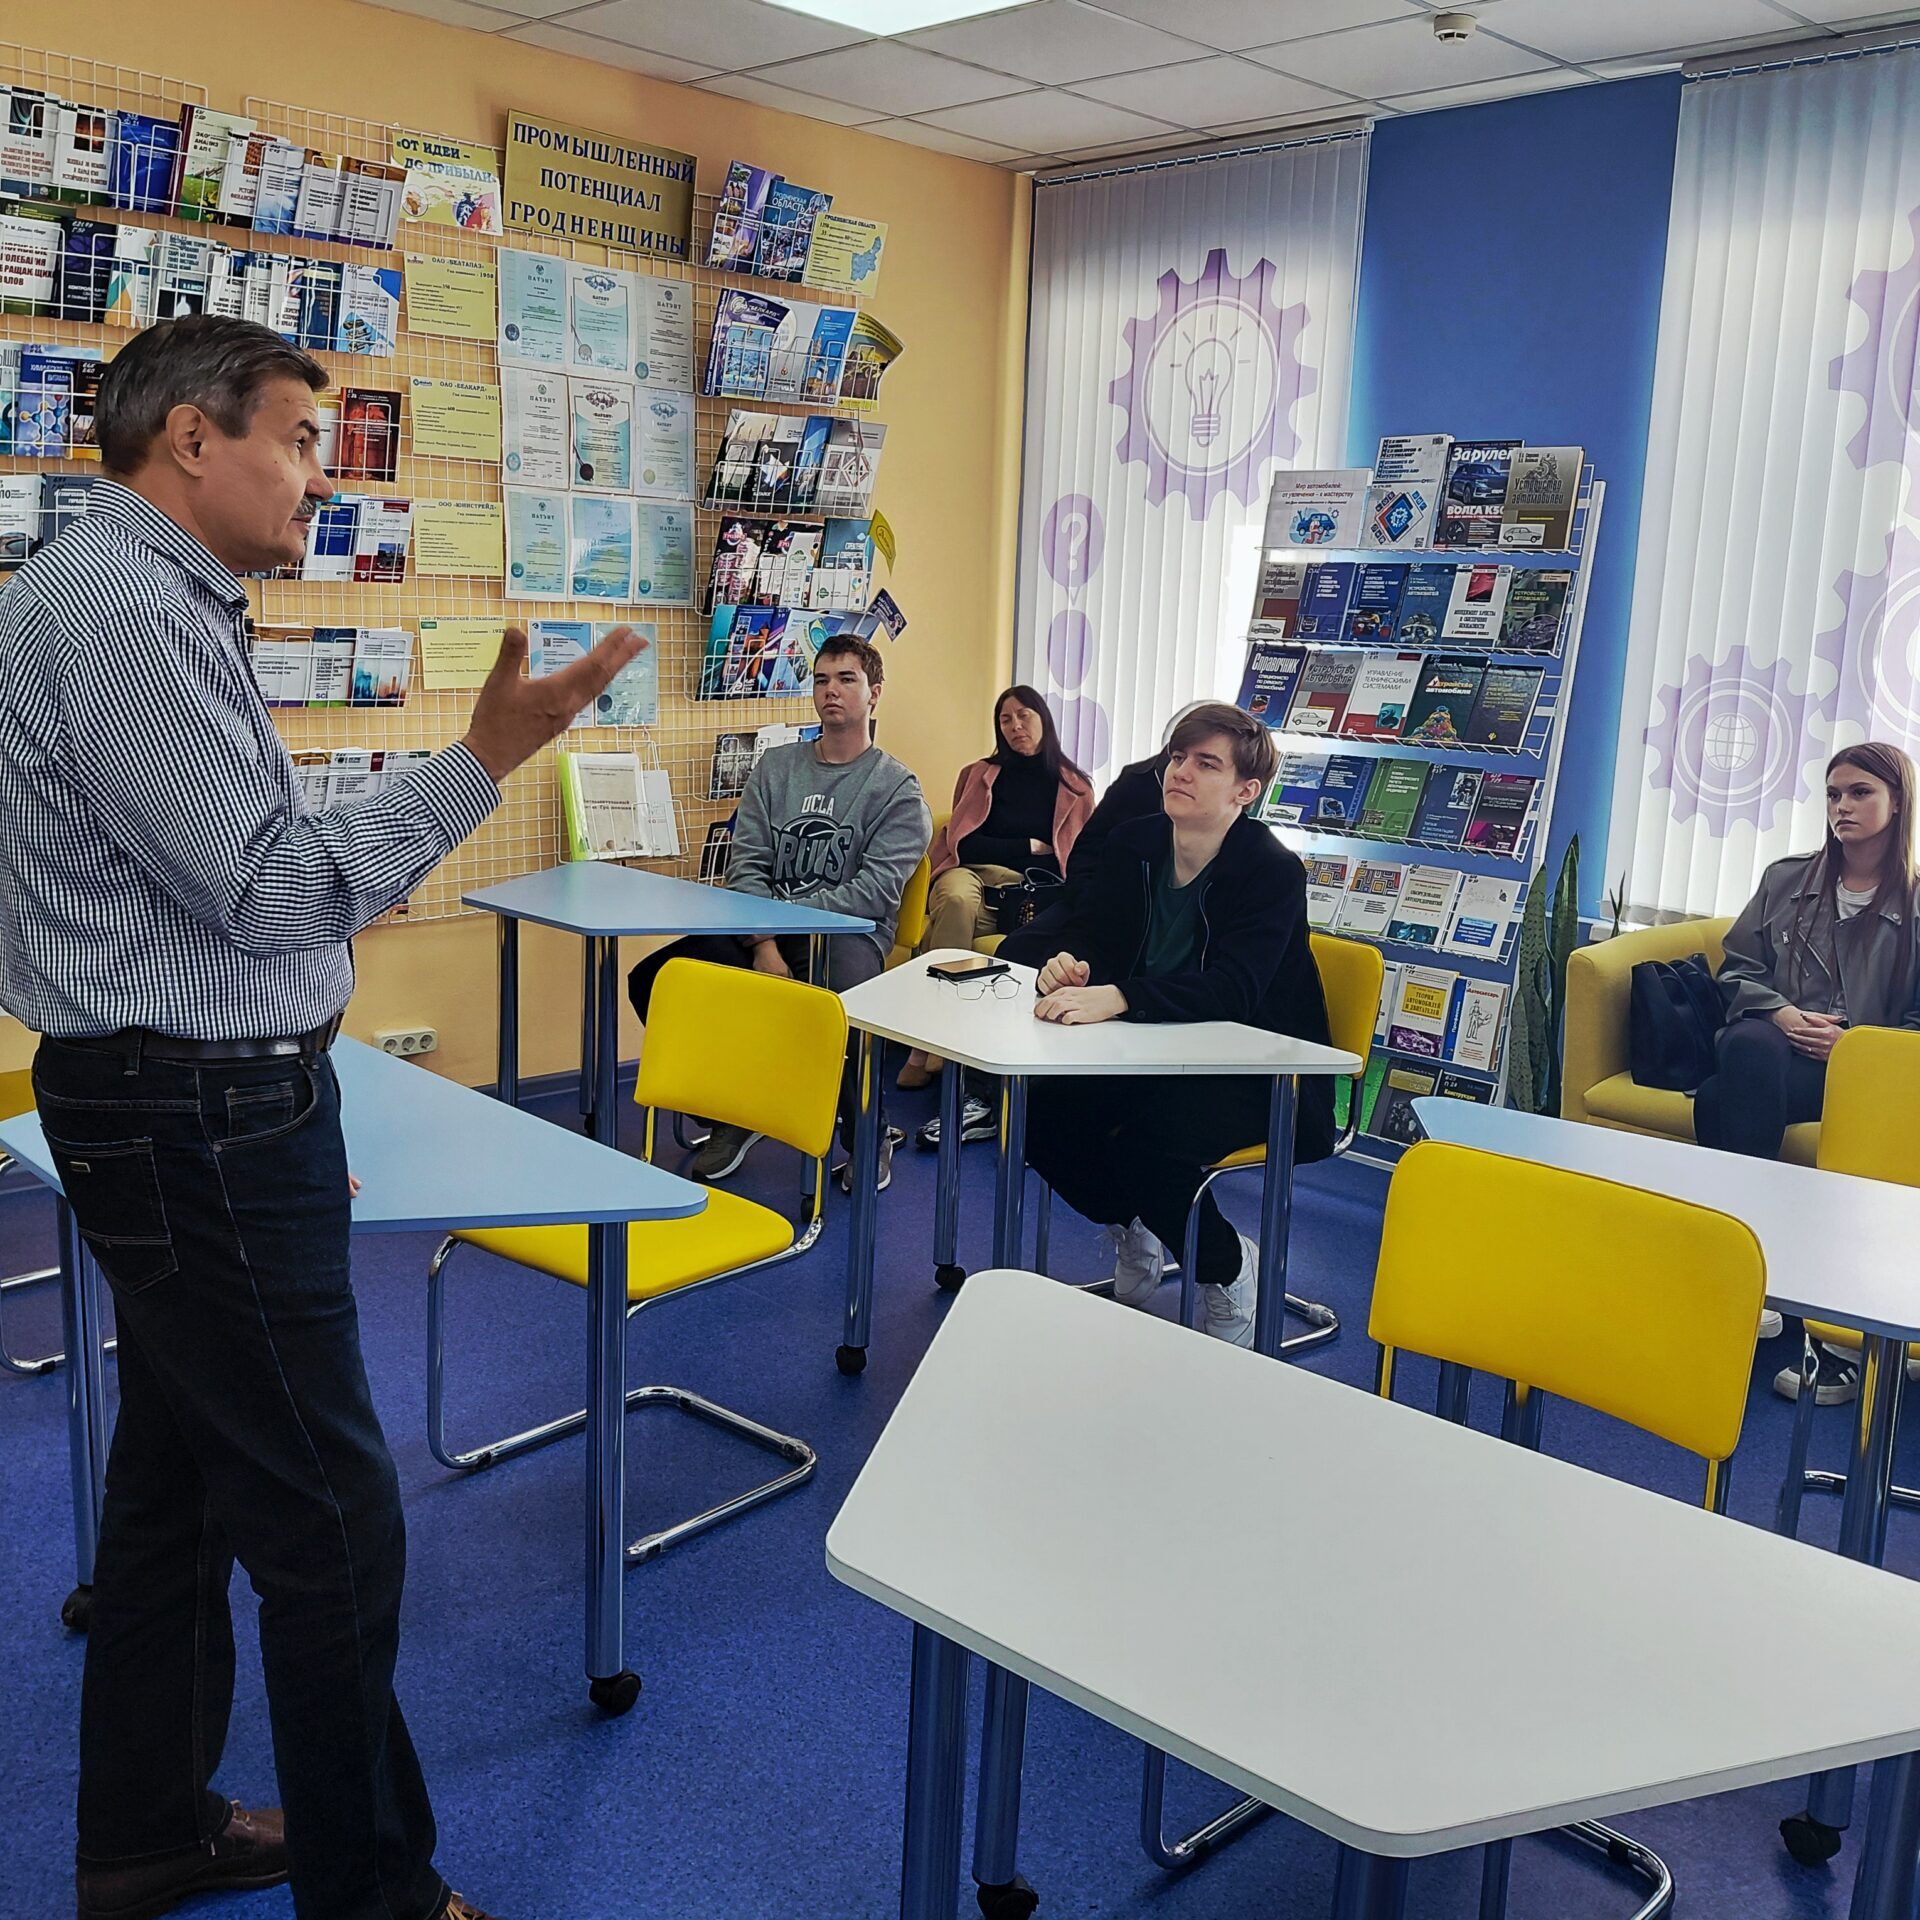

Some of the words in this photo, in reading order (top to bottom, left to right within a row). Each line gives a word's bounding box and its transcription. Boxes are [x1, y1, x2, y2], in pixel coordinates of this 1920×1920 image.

[422, 142, 461, 160] ИДЕИ
[513, 122, 695, 184] ПРОМЫШЛЕННЫЙ
[539, 167, 662, 212] ПОТЕНЦИАЛ
[772, 197, 805, 213] ОБЛАСТЬ
[509, 200, 686, 256] ГРОДНЕНЩИНЫ
[1446, 505, 1482, 515] ВОЛГА
[1251, 652, 1300, 674] Справочник
[1364, 676, 1412, 684] ТЕХНИЧЕСКИМИ
[1425, 687, 1472, 695] автомобиля
[801, 794, 835, 816] UCLA
[1415, 991, 1434, 1001] ТЕОРИЯ
[1466, 987, 1499, 998] Автослесарь
[1443, 1088, 1476, 1101] Конструкция
